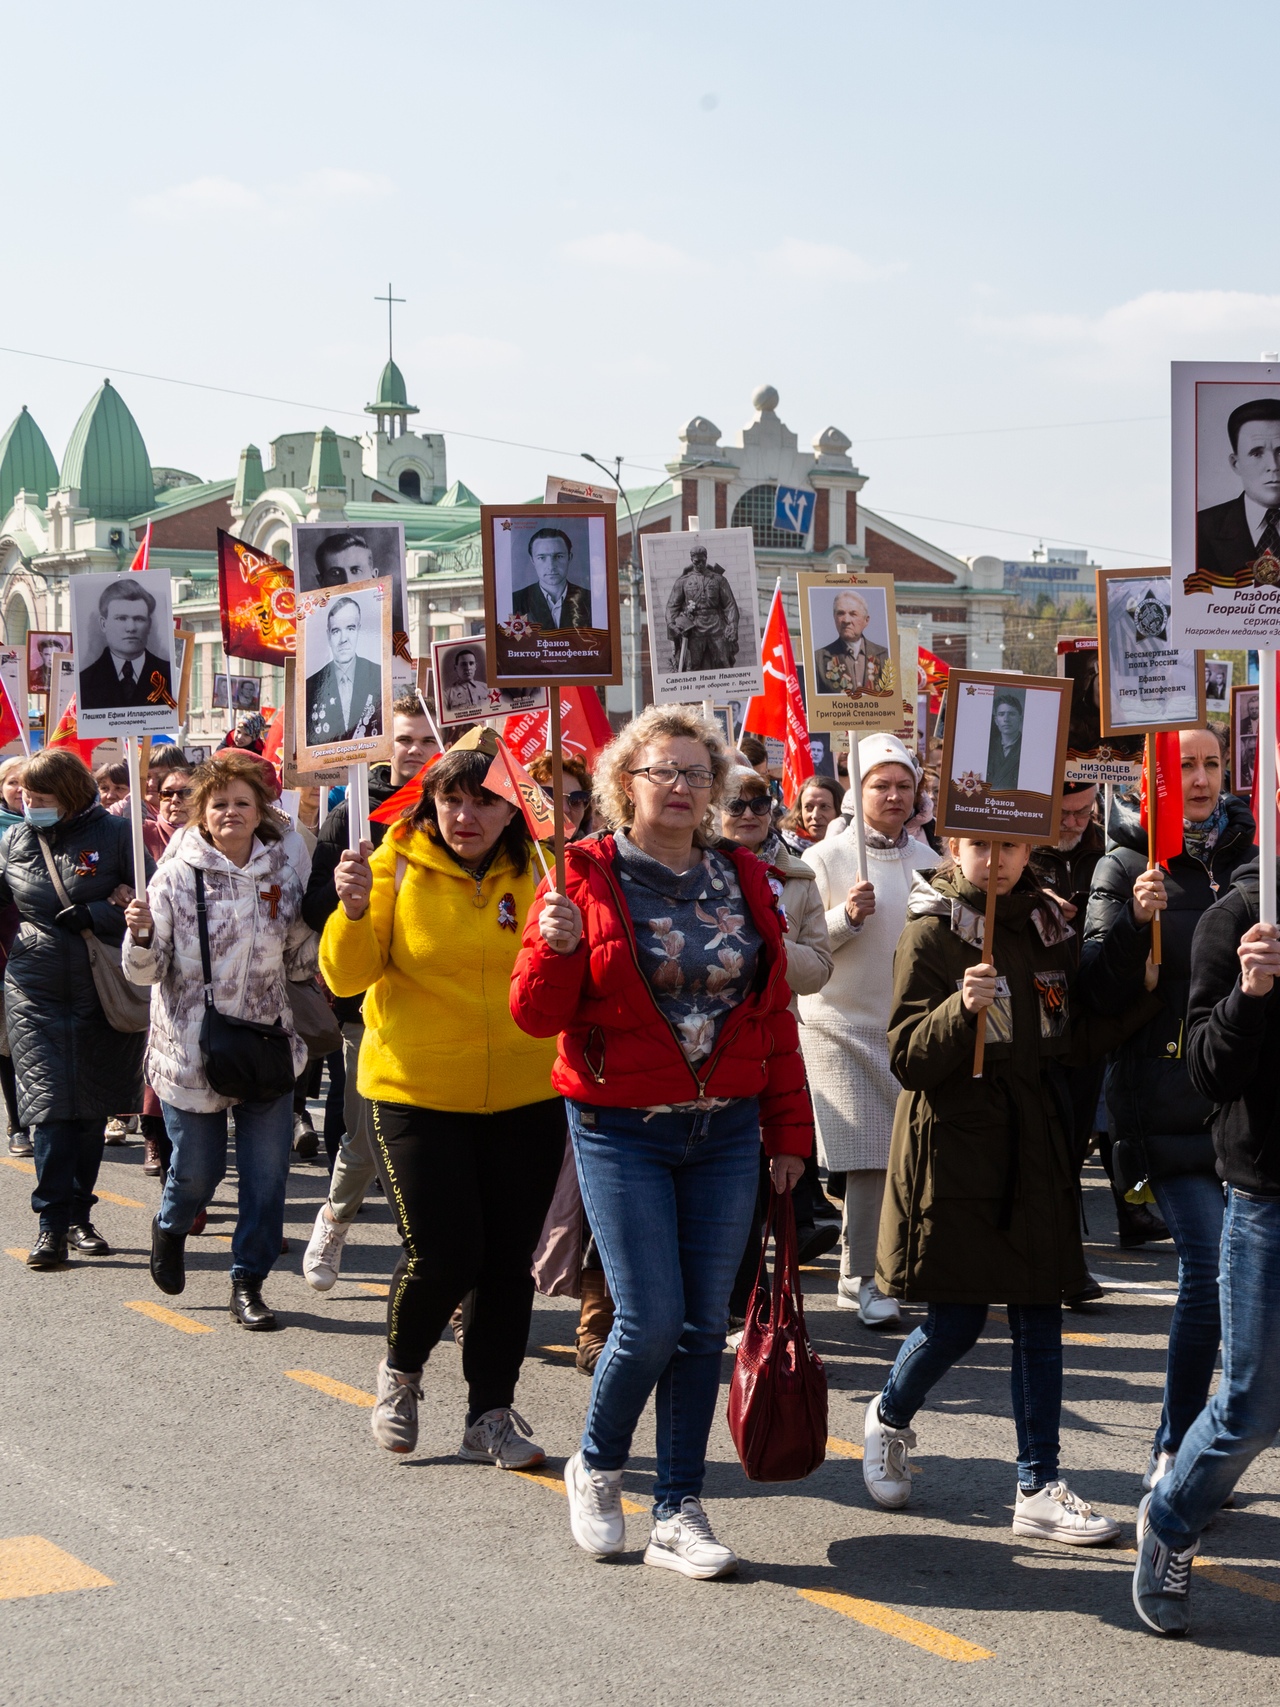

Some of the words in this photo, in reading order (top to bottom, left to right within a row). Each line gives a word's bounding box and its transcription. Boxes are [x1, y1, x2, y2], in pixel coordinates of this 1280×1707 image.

[1021, 566, 1080, 581] АКЦЕПТ
[1206, 603, 1257, 616] Георгий
[1184, 627, 1230, 637] Награжден
[1231, 628, 1268, 637] медалью
[536, 639, 570, 649] Ефанов
[507, 649, 541, 659] Виктор
[542, 648, 600, 659] Тимофеевич
[1124, 648, 1179, 660] Бессмертный
[1128, 661, 1148, 669] полк
[1149, 658, 1178, 668] России
[665, 677, 697, 685] Савельев
[718, 671, 751, 680] Иванович
[738, 679, 757, 687] Бреста
[1138, 675, 1166, 684] Ефанов
[1119, 688, 1138, 697] Петр
[1138, 684, 1187, 695] Тимофеевич
[831, 700, 880, 709] Коновалов
[82, 713, 107, 721] Пешков
[107, 711, 126, 720] Ефим
[127, 709, 173, 718] Илларионович
[816, 710, 851, 719] Григорий
[852, 709, 896, 718] Степанович
[336, 745, 358, 754] Сергей
[1080, 763, 1131, 774] НИЗОВЦЕВ
[314, 772, 341, 780] Рядовой
[1066, 770, 1098, 781] Сергей
[1100, 772, 1141, 783] Петрови
[984, 797, 1015, 807] Ефанов
[954, 804, 990, 814] Василий
[991, 807, 1044, 819] Тимофеевич
